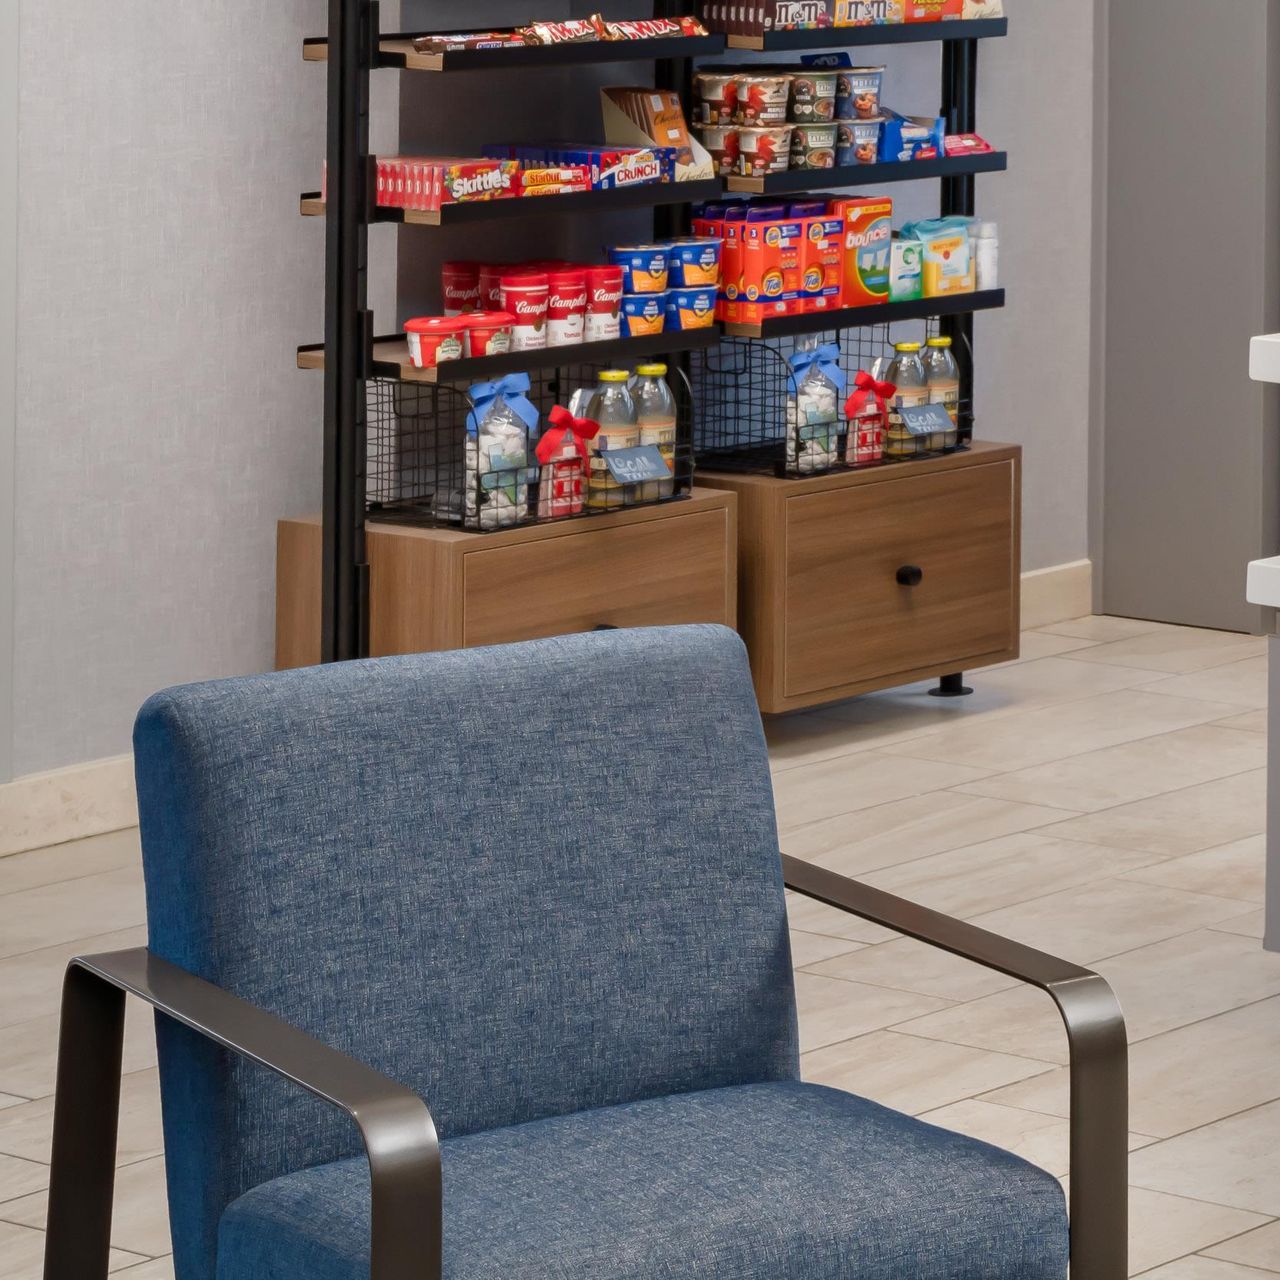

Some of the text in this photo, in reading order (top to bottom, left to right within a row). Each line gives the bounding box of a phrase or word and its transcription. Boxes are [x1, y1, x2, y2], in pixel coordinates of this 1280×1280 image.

[529, 172, 561, 184] Starbur
[617, 163, 658, 182] CRUNCH
[451, 169, 510, 198] Skittles
[846, 226, 889, 250] bounce
